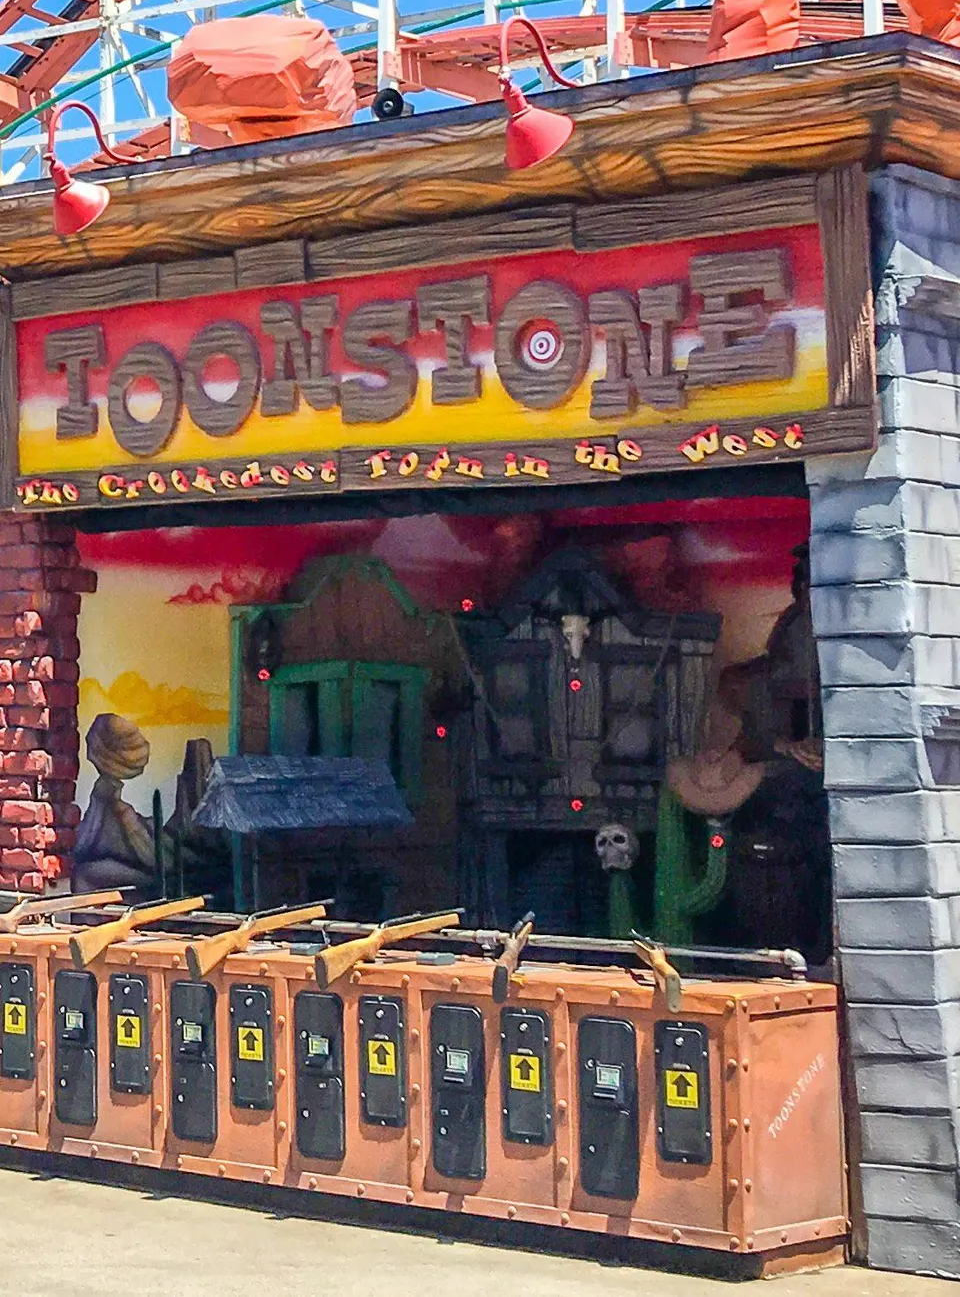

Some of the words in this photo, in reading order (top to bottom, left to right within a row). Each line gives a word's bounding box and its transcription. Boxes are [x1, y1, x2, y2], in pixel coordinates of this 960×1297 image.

[44, 248, 796, 457] TOONSTONE
[16, 478, 81, 505] The
[97, 460, 338, 499] Crookedest
[503, 451, 551, 479] in
[574, 439, 643, 474] the
[676, 423, 805, 464] West
[768, 1053, 825, 1139] TOONSTONE
